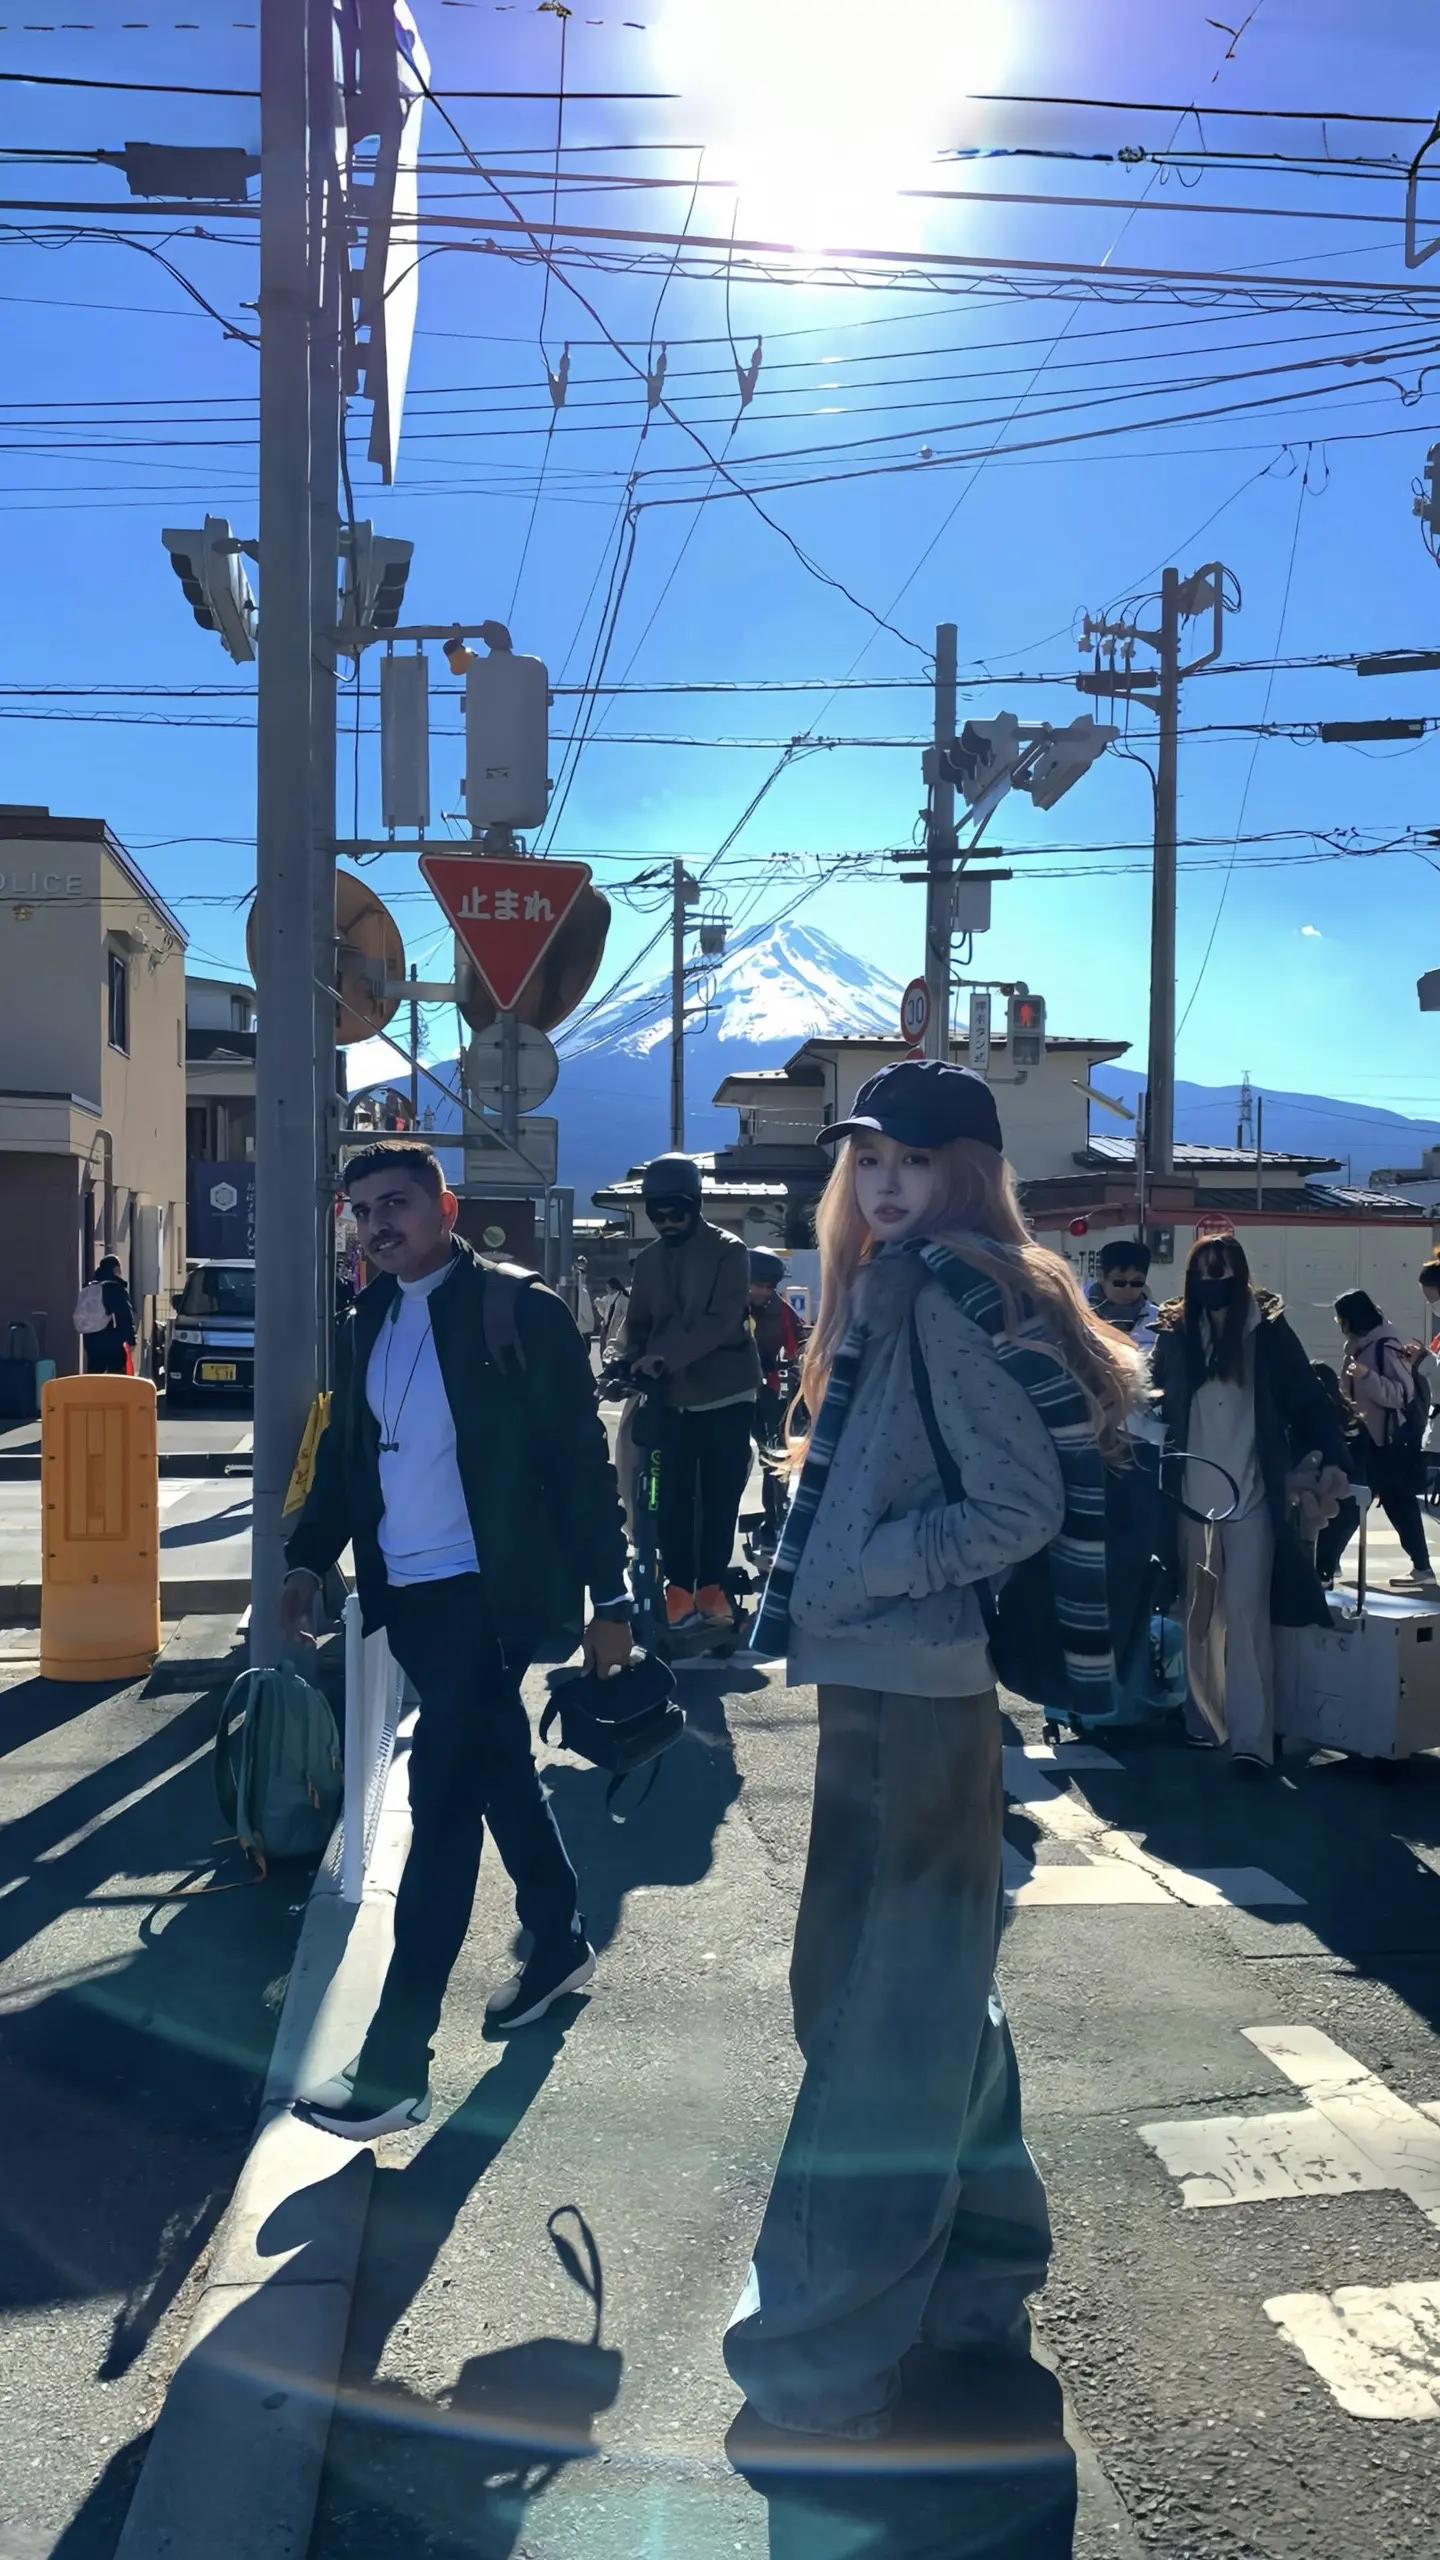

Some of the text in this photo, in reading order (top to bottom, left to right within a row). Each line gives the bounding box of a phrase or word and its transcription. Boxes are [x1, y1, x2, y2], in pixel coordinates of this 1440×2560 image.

[456, 886, 555, 922] 止まれ
[907, 996, 924, 1026] 30
